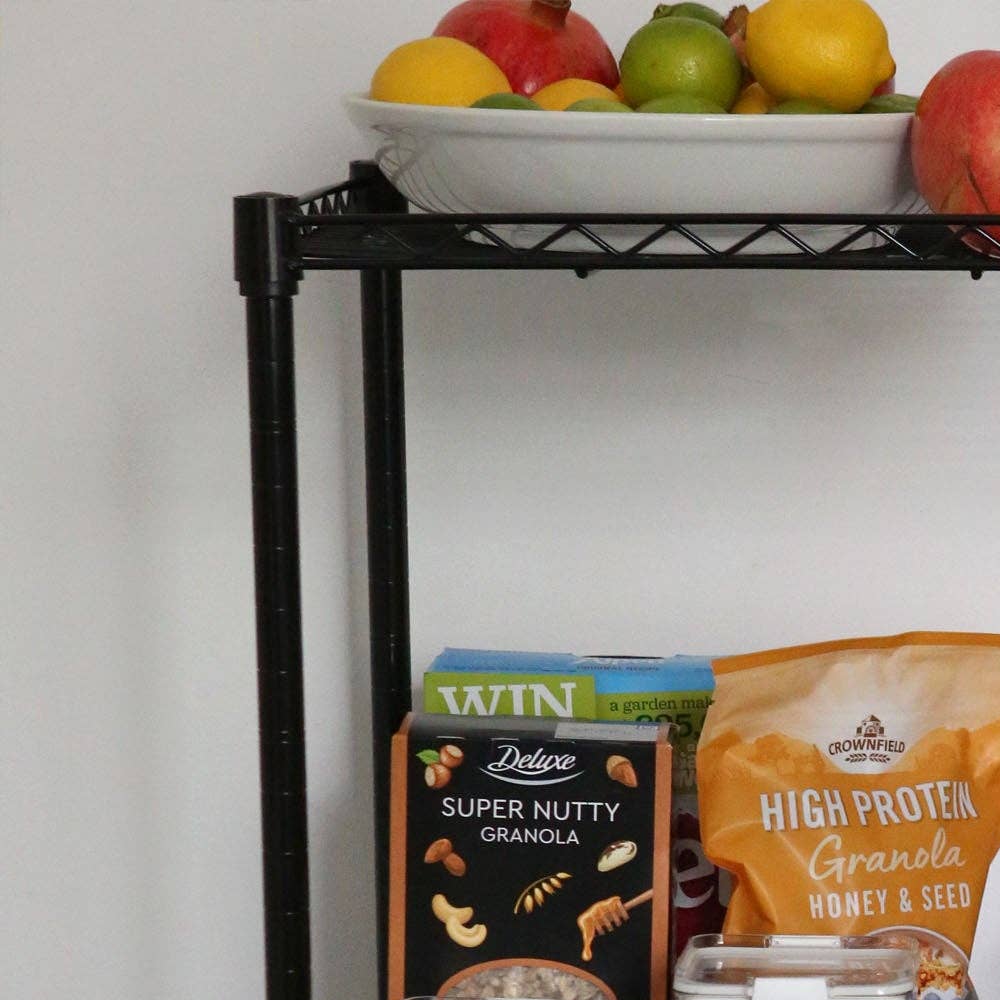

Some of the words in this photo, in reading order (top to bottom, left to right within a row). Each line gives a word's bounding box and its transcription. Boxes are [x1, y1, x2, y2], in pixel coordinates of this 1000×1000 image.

[437, 682, 576, 718] WIN
[610, 702, 618, 711] a
[623, 697, 678, 714] garden
[486, 744, 577, 776] Deluxe
[828, 739, 905, 757] CROWNFIELD
[441, 797, 524, 819] SUPER
[534, 801, 620, 822] NUTTY
[759, 788, 848, 832] HIGH
[852, 780, 978, 826] PROTEIN
[480, 826, 579, 845] GRANOLA
[808, 828, 965, 884] Granola
[809, 888, 889, 919] HONEY
[900, 888, 912, 912] &
[921, 883, 971, 911] SEED
